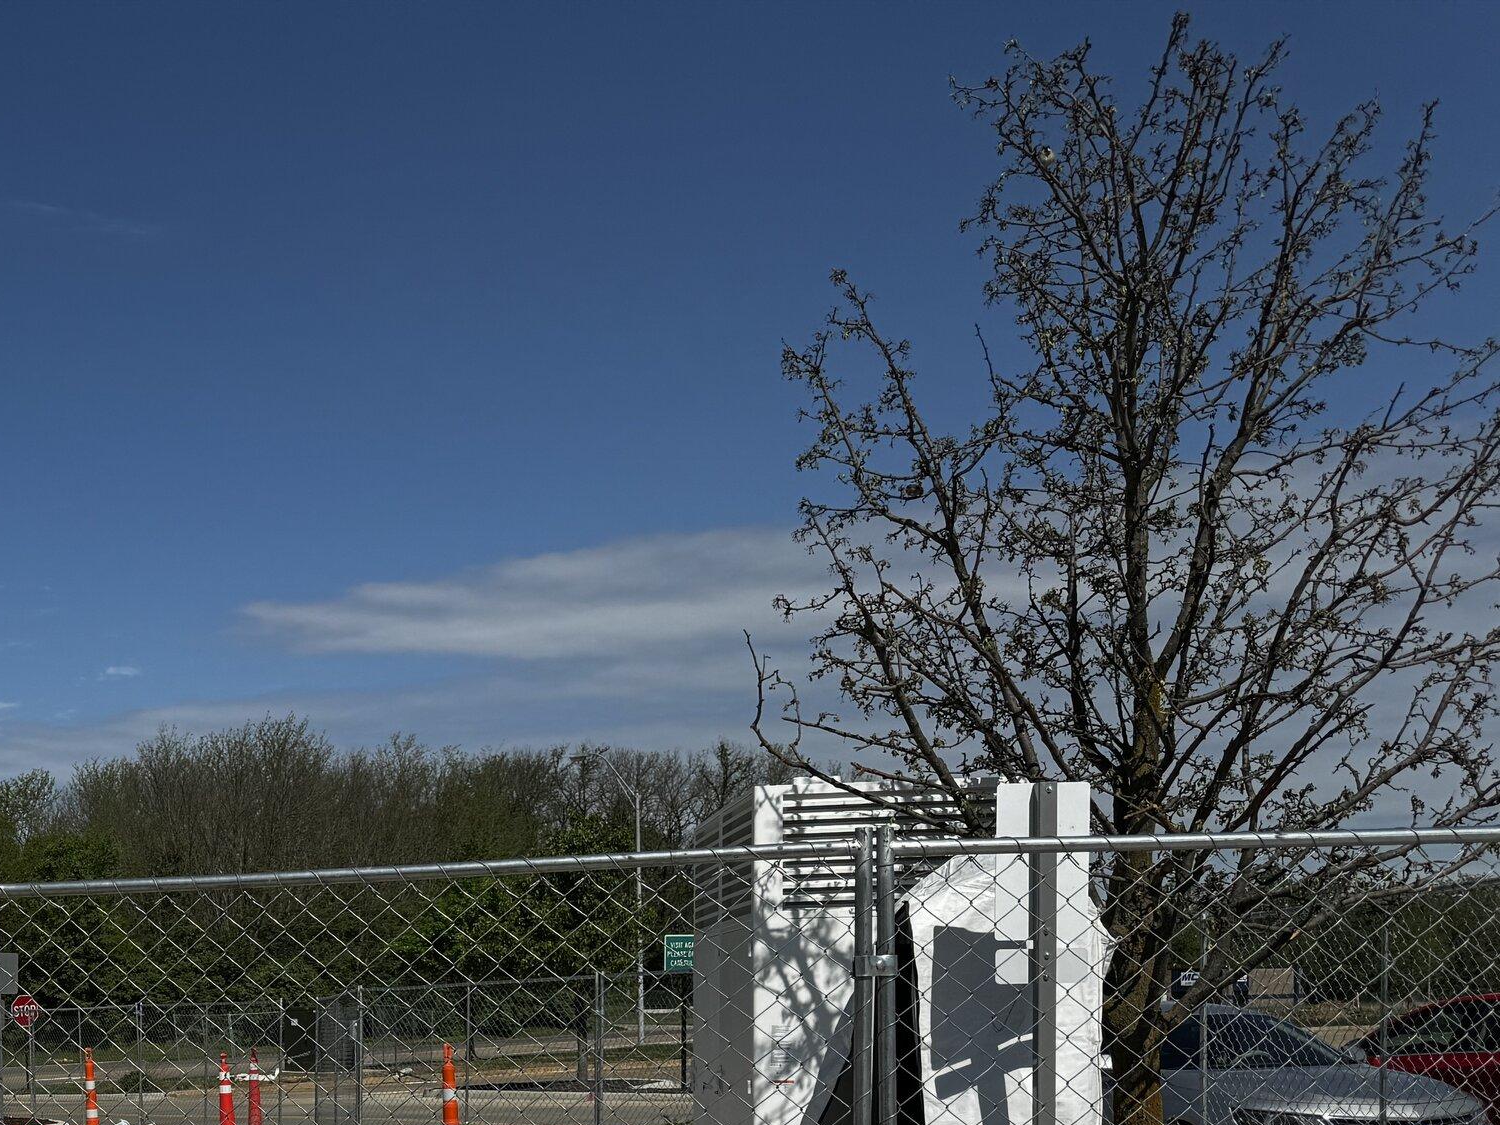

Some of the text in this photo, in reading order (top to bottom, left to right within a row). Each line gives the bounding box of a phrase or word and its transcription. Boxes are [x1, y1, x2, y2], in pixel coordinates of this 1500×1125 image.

[670, 941, 683, 949] VISIT
[667, 950, 687, 958] PLEASE
[13, 1005, 36, 1018] STOP
